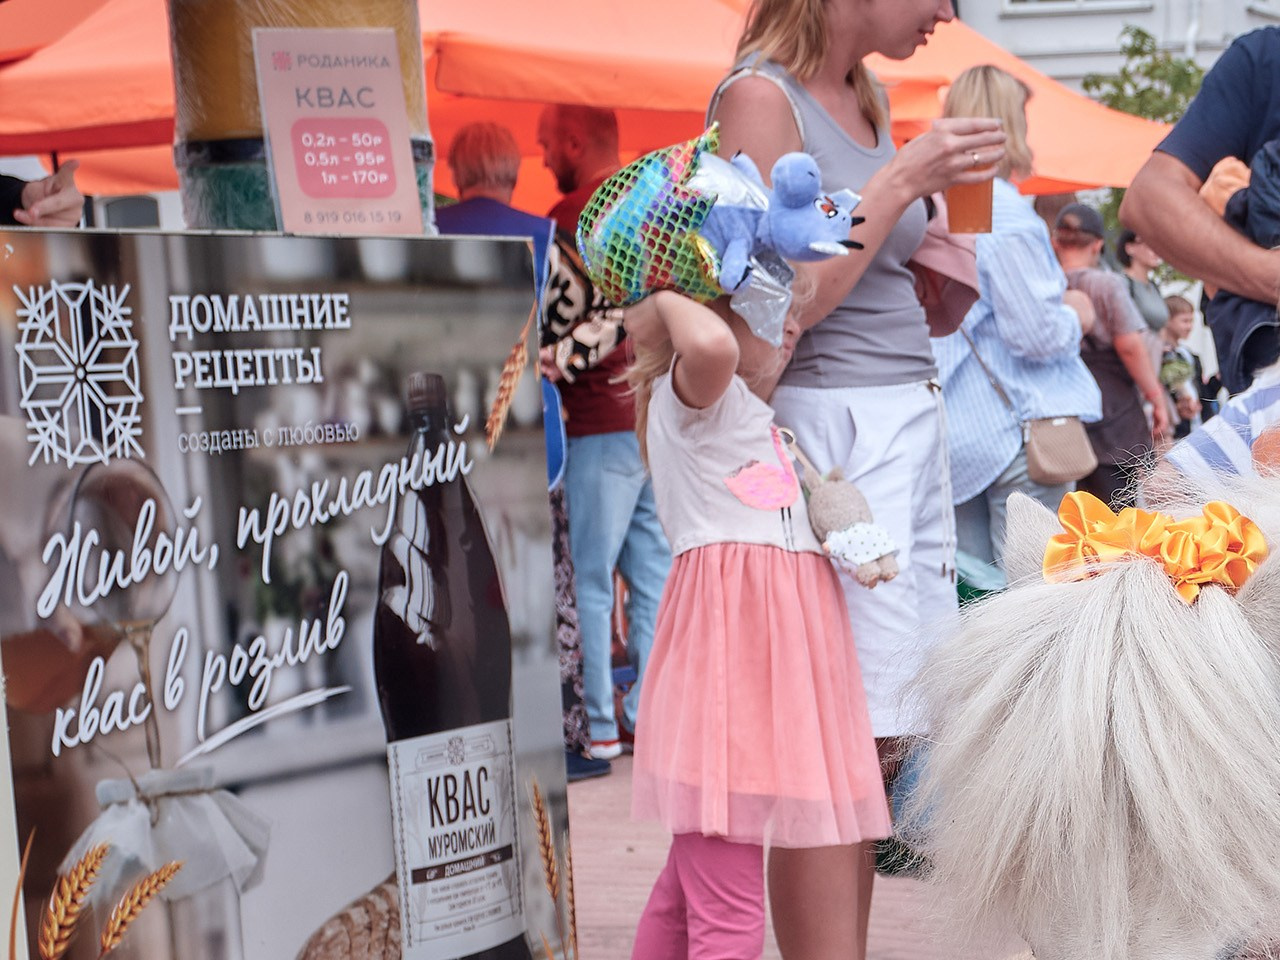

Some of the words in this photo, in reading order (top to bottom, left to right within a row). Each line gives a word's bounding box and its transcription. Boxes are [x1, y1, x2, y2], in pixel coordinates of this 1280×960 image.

[296, 54, 391, 69] РОДАНИКА
[295, 86, 376, 109] КВАС
[301, 132, 336, 149] 0,2л
[351, 132, 383, 148] 50р
[304, 151, 339, 168] 0,5л
[354, 151, 386, 166] 95р
[321, 170, 338, 185] 1л
[352, 170, 389, 185] 170р
[303, 210, 312, 224] 8
[168, 293, 352, 342] ДОМАШНИЕ
[171, 347, 324, 395] РЕЦЕПТЫ
[177, 428, 260, 455] созданы
[263, 429, 275, 448] с
[277, 419, 360, 447] любовью
[36, 496, 219, 619] Живой,
[236, 413, 474, 585] прохладный
[51, 656, 152, 757] квас
[164, 626, 189, 711] в
[197, 570, 350, 742] розлив
[426, 766, 491, 829] КВАС
[427, 816, 497, 860] МУРОМСКИЙ
